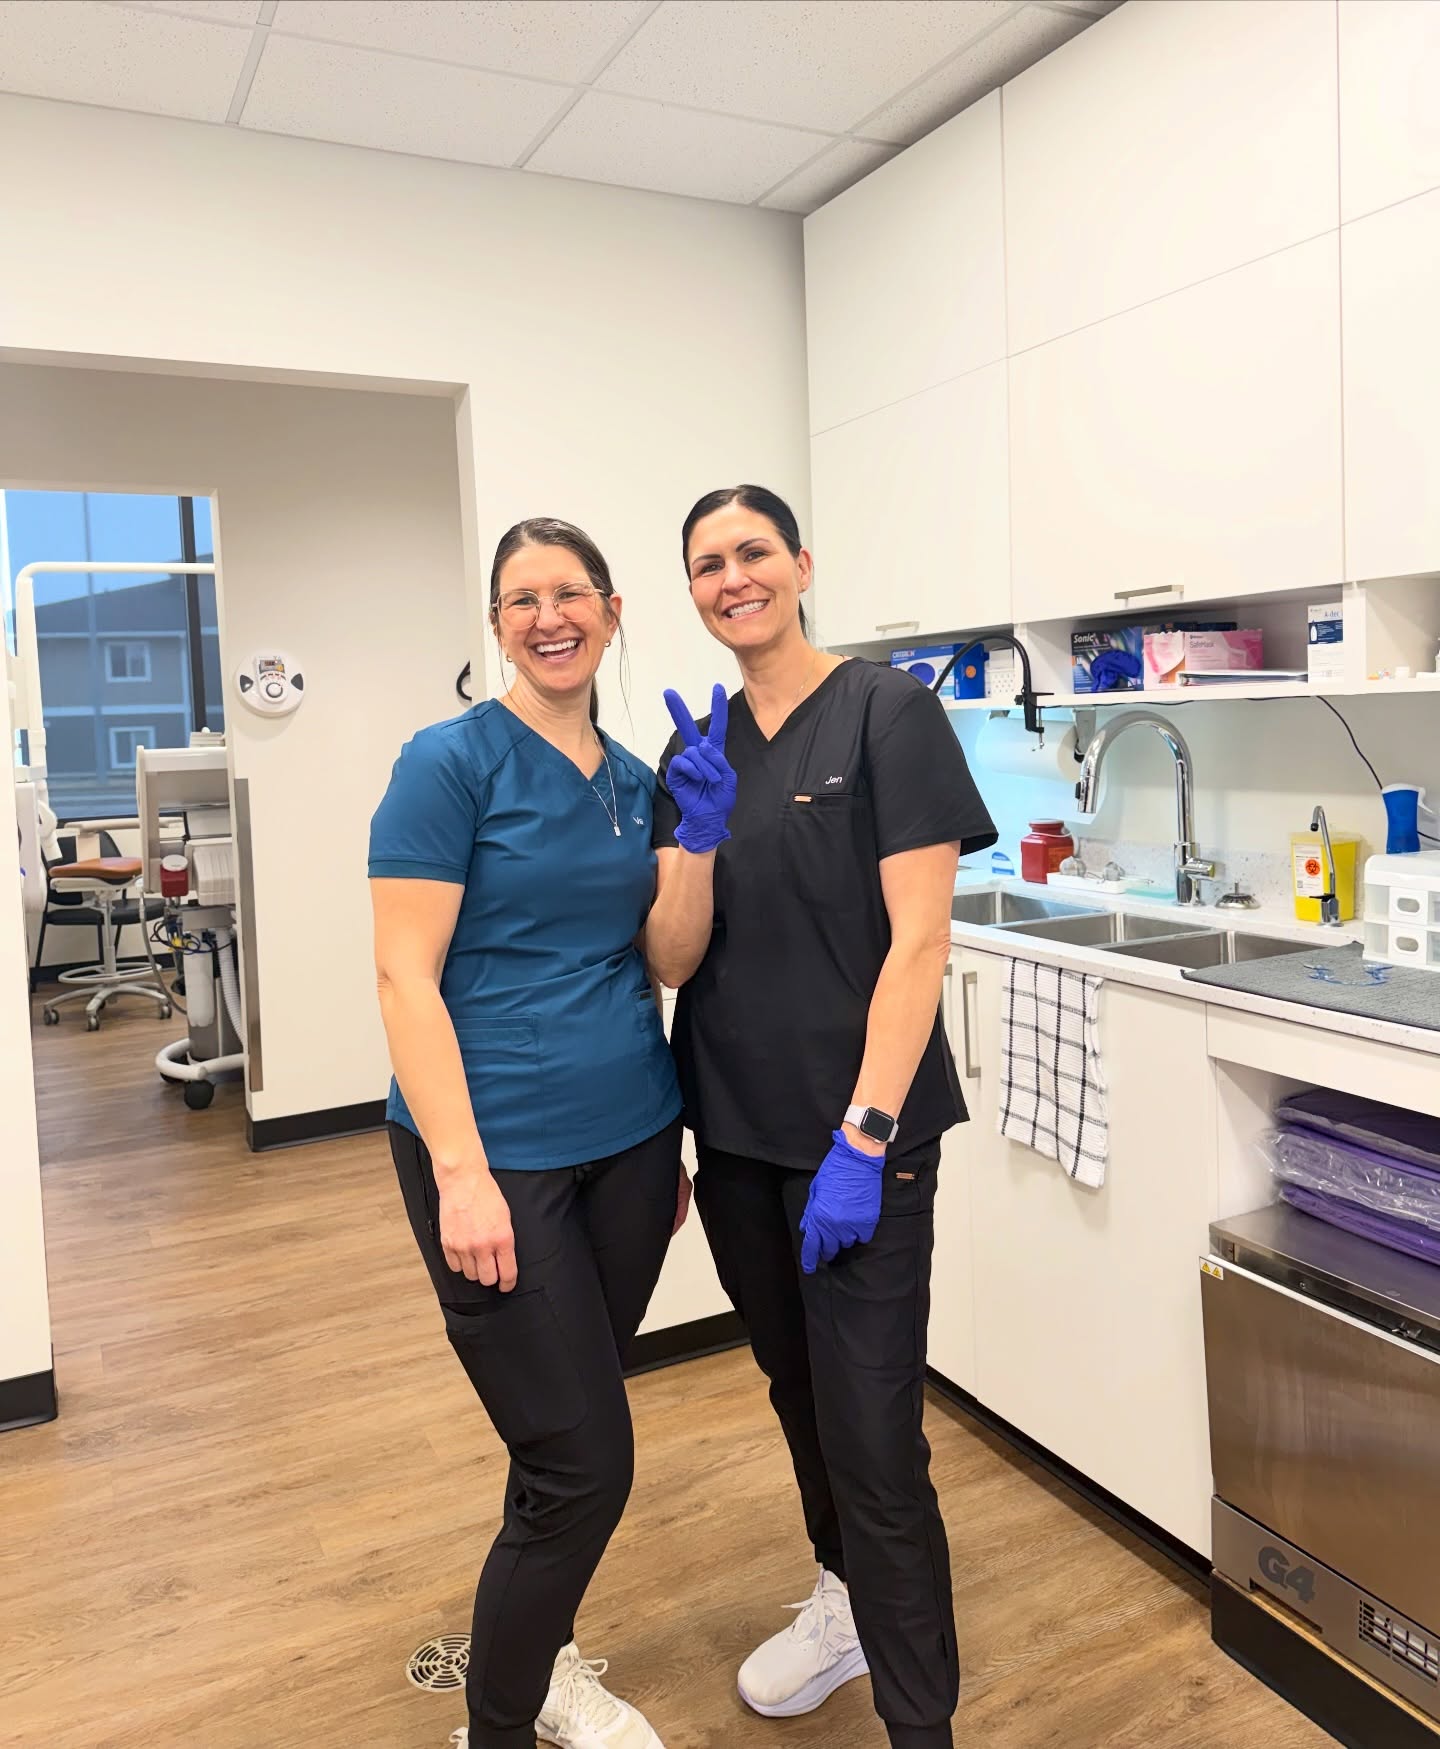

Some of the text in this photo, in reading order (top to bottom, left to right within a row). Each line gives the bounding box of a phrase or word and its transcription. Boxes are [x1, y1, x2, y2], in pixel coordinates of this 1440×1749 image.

[1073, 632, 1095, 644] Sonic
[825, 776, 843, 785] Jen
[1258, 1546, 1316, 1604] G4
